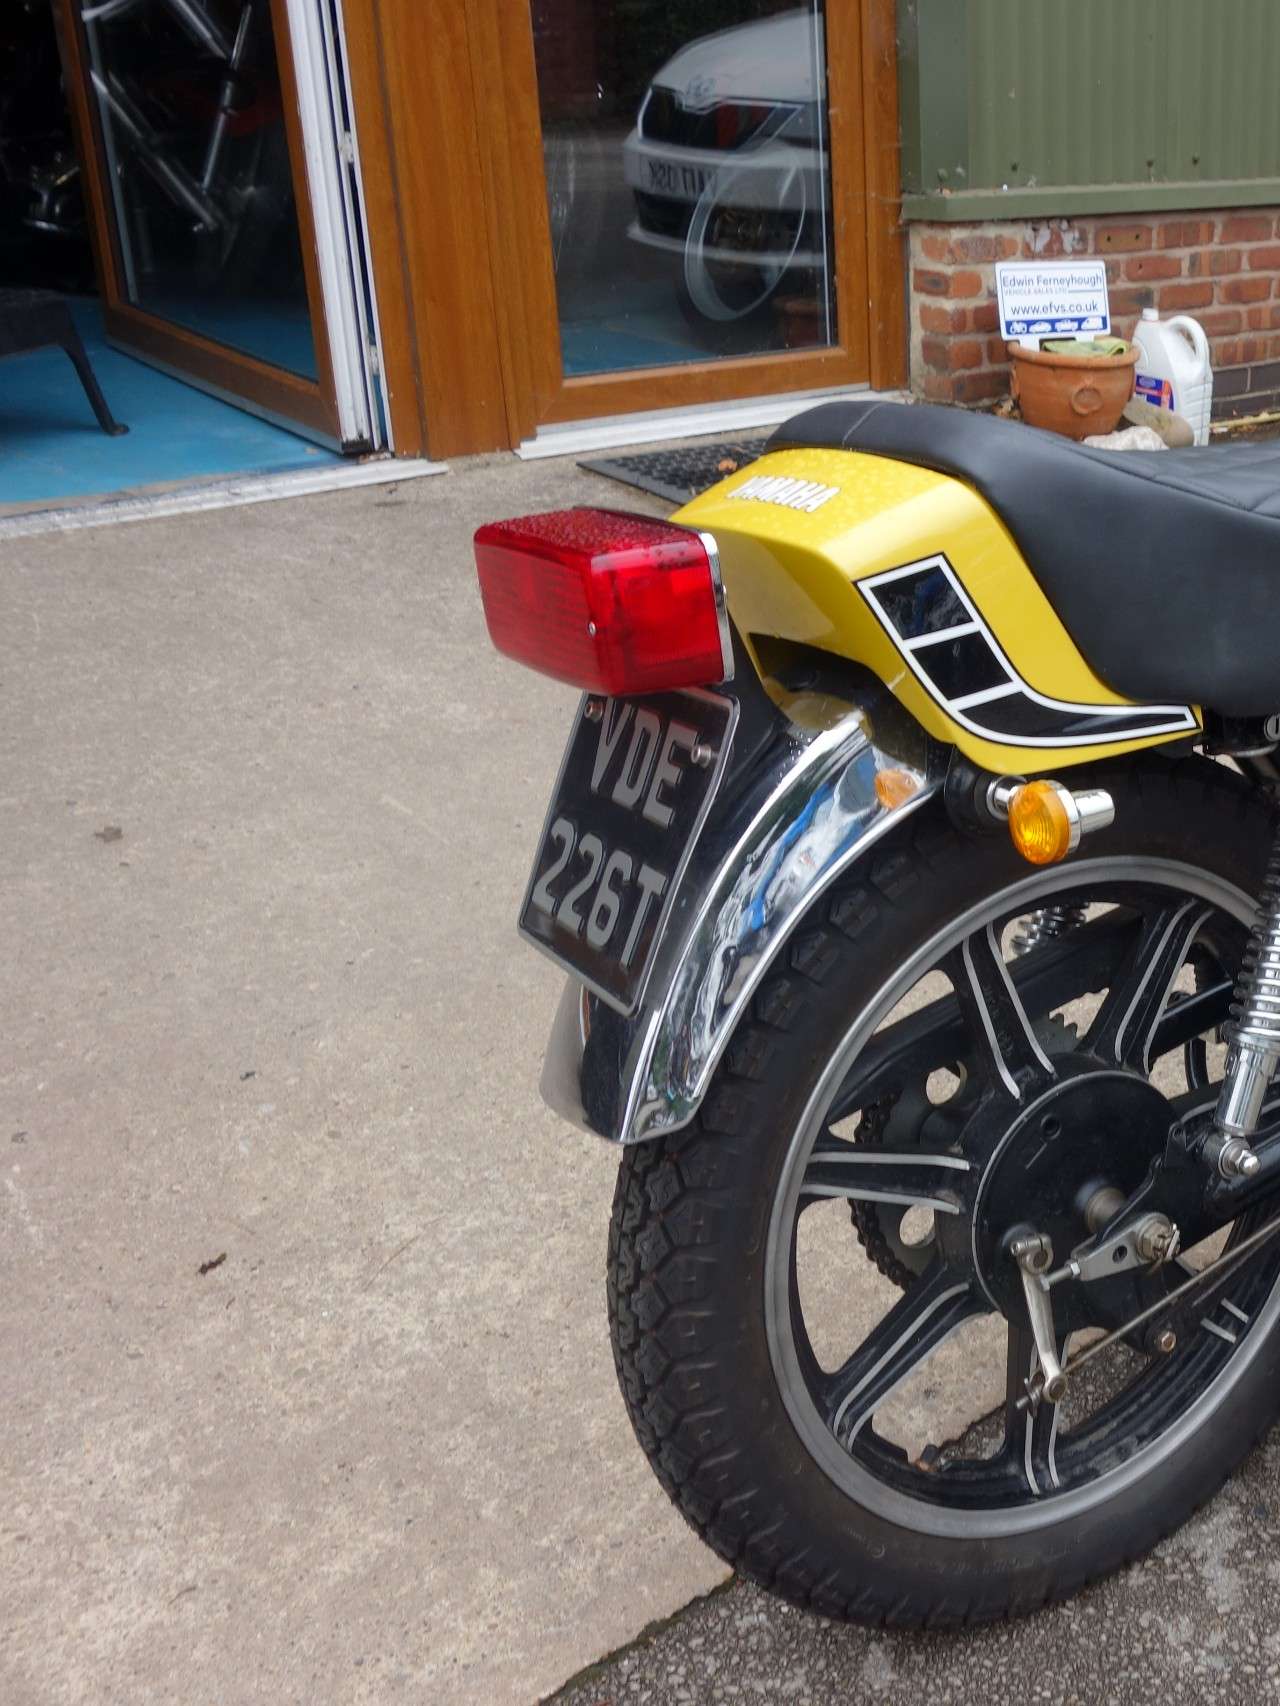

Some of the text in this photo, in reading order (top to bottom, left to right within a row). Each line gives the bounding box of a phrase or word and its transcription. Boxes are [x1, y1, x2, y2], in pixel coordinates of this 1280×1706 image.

[1003, 273, 1102, 288] Edwin Ferneyhough
[1011, 299, 1098, 316] www.efvs.co.uk
[724, 475, 841, 513] YAMAHA
[591, 696, 699, 829] VDE
[532, 817, 668, 973] 226T
